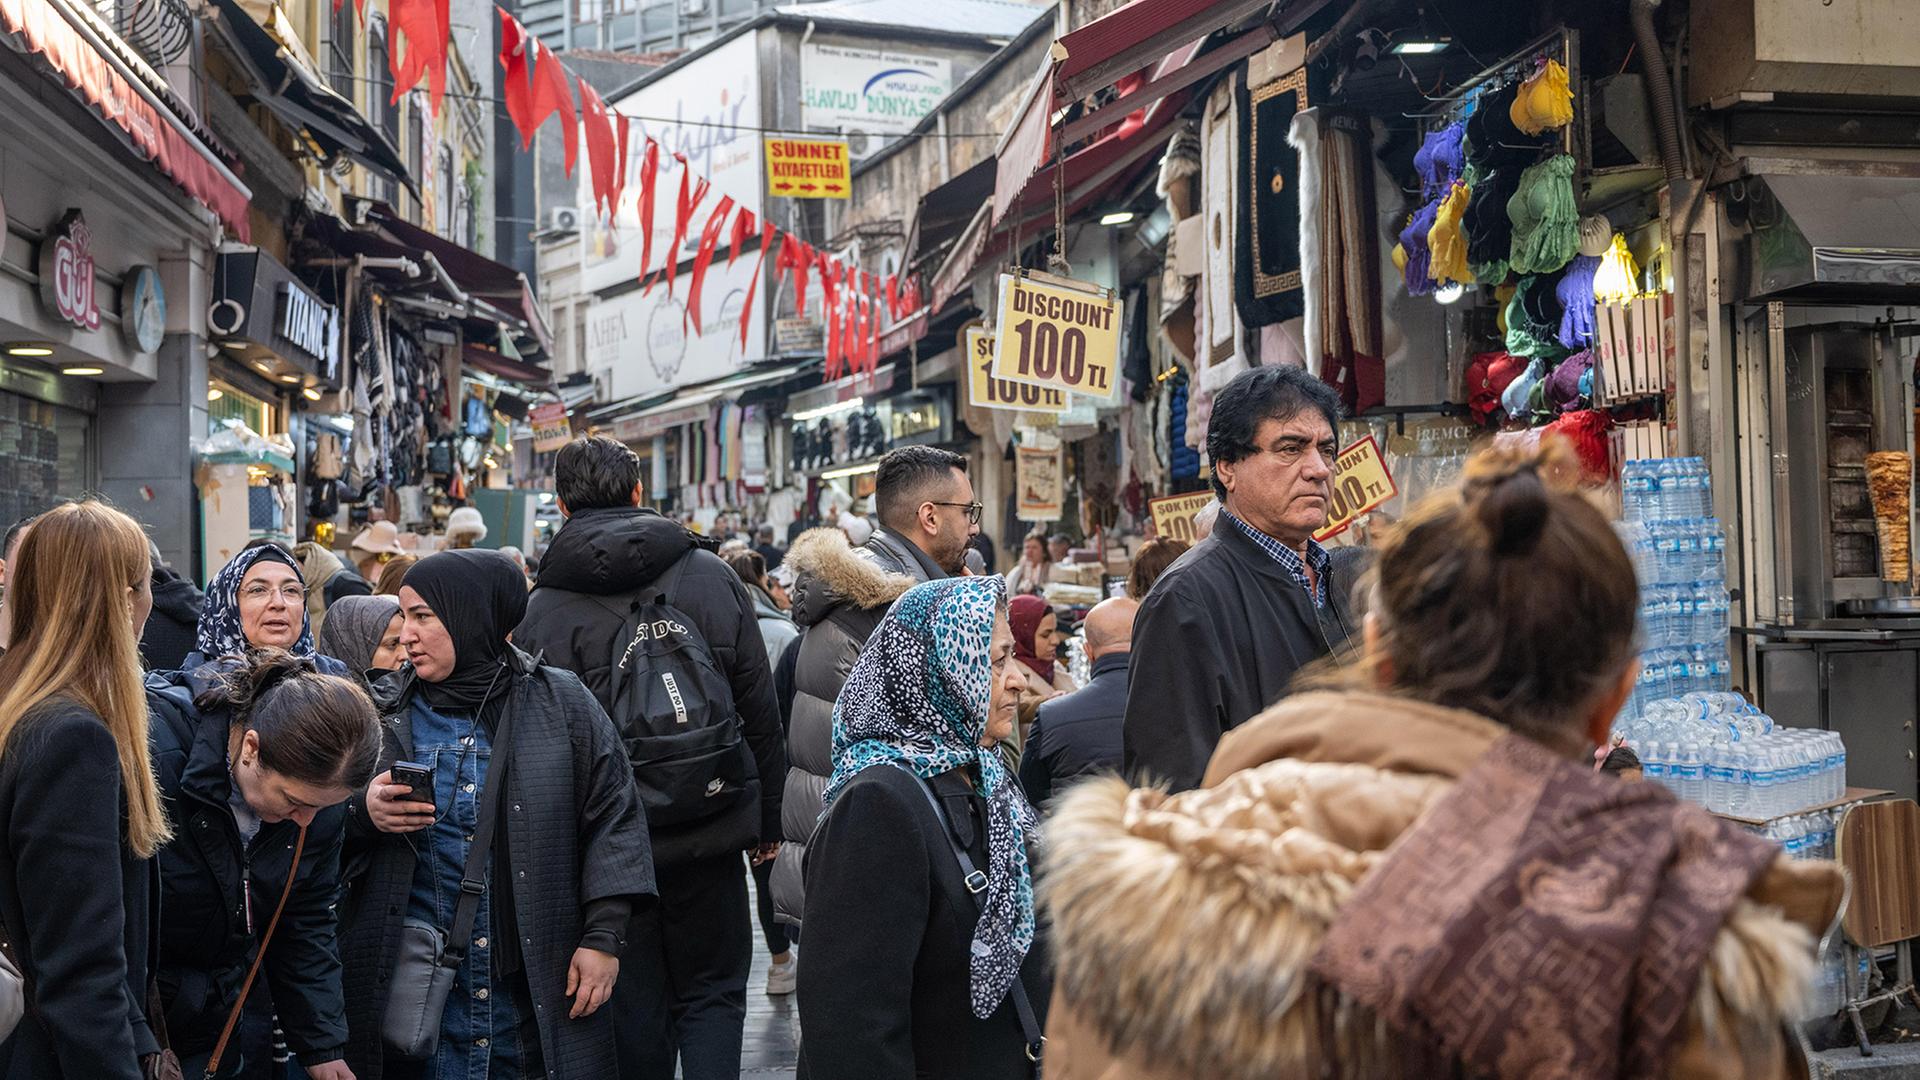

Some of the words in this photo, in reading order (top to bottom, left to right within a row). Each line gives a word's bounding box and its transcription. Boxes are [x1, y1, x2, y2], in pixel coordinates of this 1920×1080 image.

[805, 88, 858, 111] HAVLU
[771, 140, 842, 160] SÜNNET
[773, 161, 844, 180] KIYAFETLERİ
[55, 240, 100, 328] GÜL
[1013, 288, 1114, 331] DISCOUNT
[1015, 318, 1086, 386] 100
[1088, 363, 1108, 390] TL
[1335, 446, 1369, 476] OUNT
[1157, 501, 1182, 516] ŞOK
[1324, 475, 1367, 530] 00
[1366, 480, 1386, 499] TL
[665, 677, 678, 695] JUST
[672, 695, 682, 706] DO
